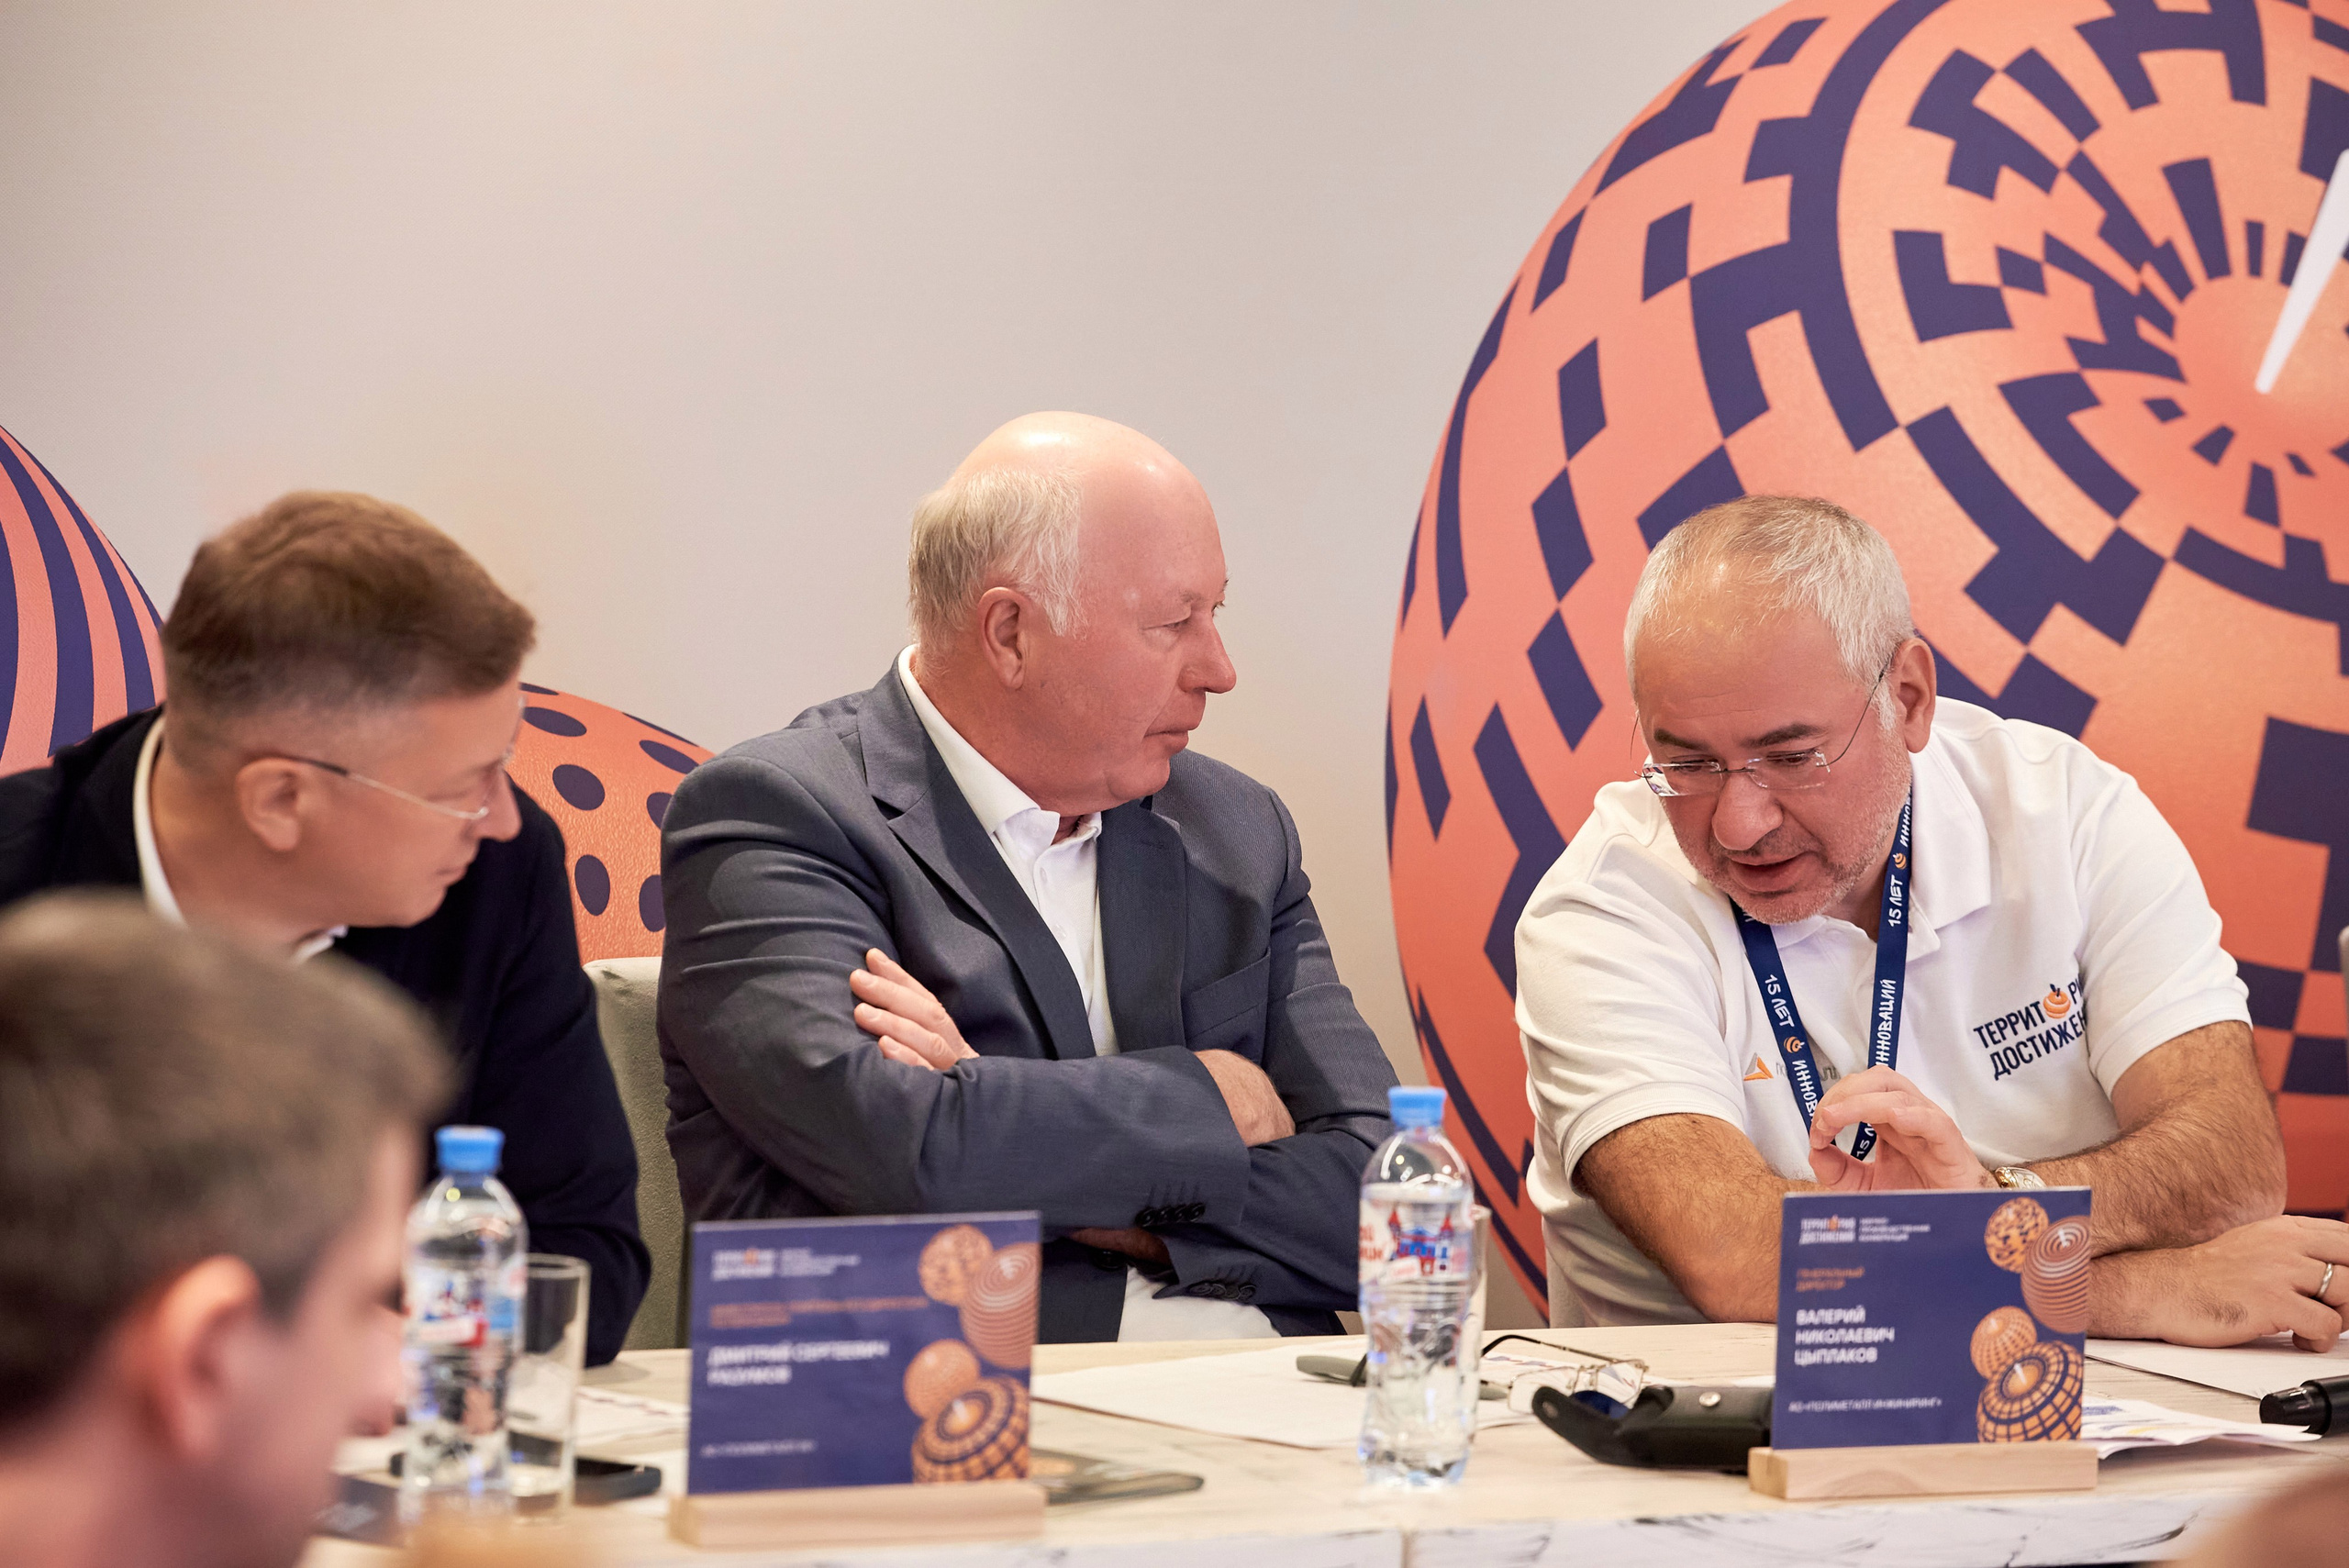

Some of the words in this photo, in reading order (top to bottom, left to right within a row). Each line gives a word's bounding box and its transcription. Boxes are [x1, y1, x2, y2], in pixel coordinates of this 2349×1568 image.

[1890, 874, 1904, 907] ЛЕТ
[1887, 908, 1902, 928] 15
[1765, 973, 1781, 995] 15
[1771, 997, 1795, 1029] ЛЕТ
[1876, 979, 1897, 1066] ННОВАЦИЙ
[1791, 1059, 1820, 1123] ИННОВ
[1796, 1305, 1866, 1326] ВАЛЕРИЙ
[1794, 1327, 1896, 1346] НИКОЛАЕВИЧ
[1794, 1347, 1878, 1367] ЦЫПЛАКОВ
